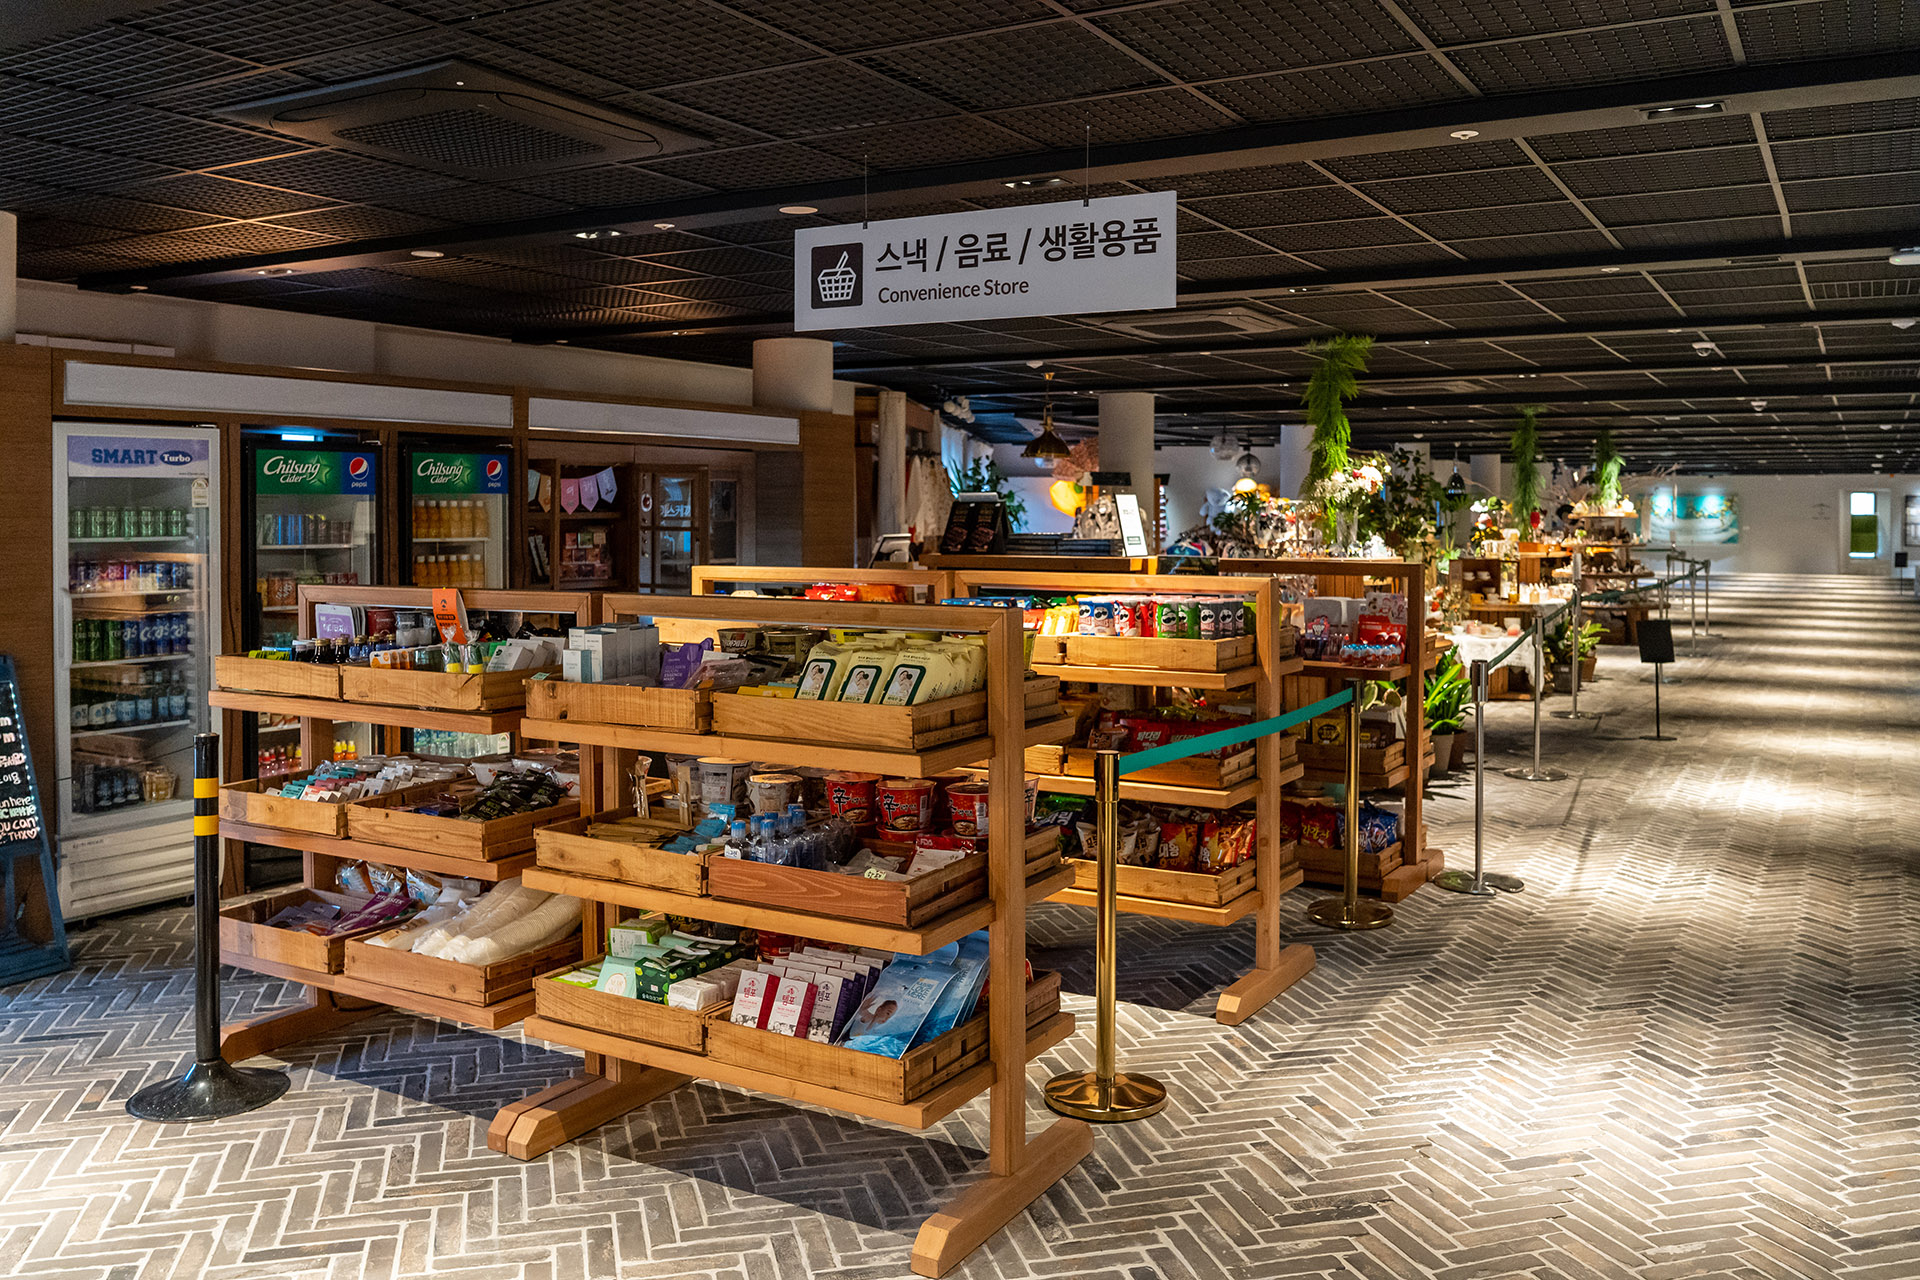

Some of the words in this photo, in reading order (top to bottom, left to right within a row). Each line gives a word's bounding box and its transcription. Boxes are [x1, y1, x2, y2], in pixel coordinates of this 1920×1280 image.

[875, 238, 928, 273] 스낵
[954, 233, 1011, 269] 음료
[1038, 216, 1162, 263] 생활용품
[878, 283, 981, 304] Convenience
[984, 278, 1030, 297] Store
[91, 448, 158, 464] SMART
[162, 453, 191, 463] Turbo
[280, 473, 304, 484] Cider
[430, 474, 452, 485] Cider
[12, 817, 37, 830] can
